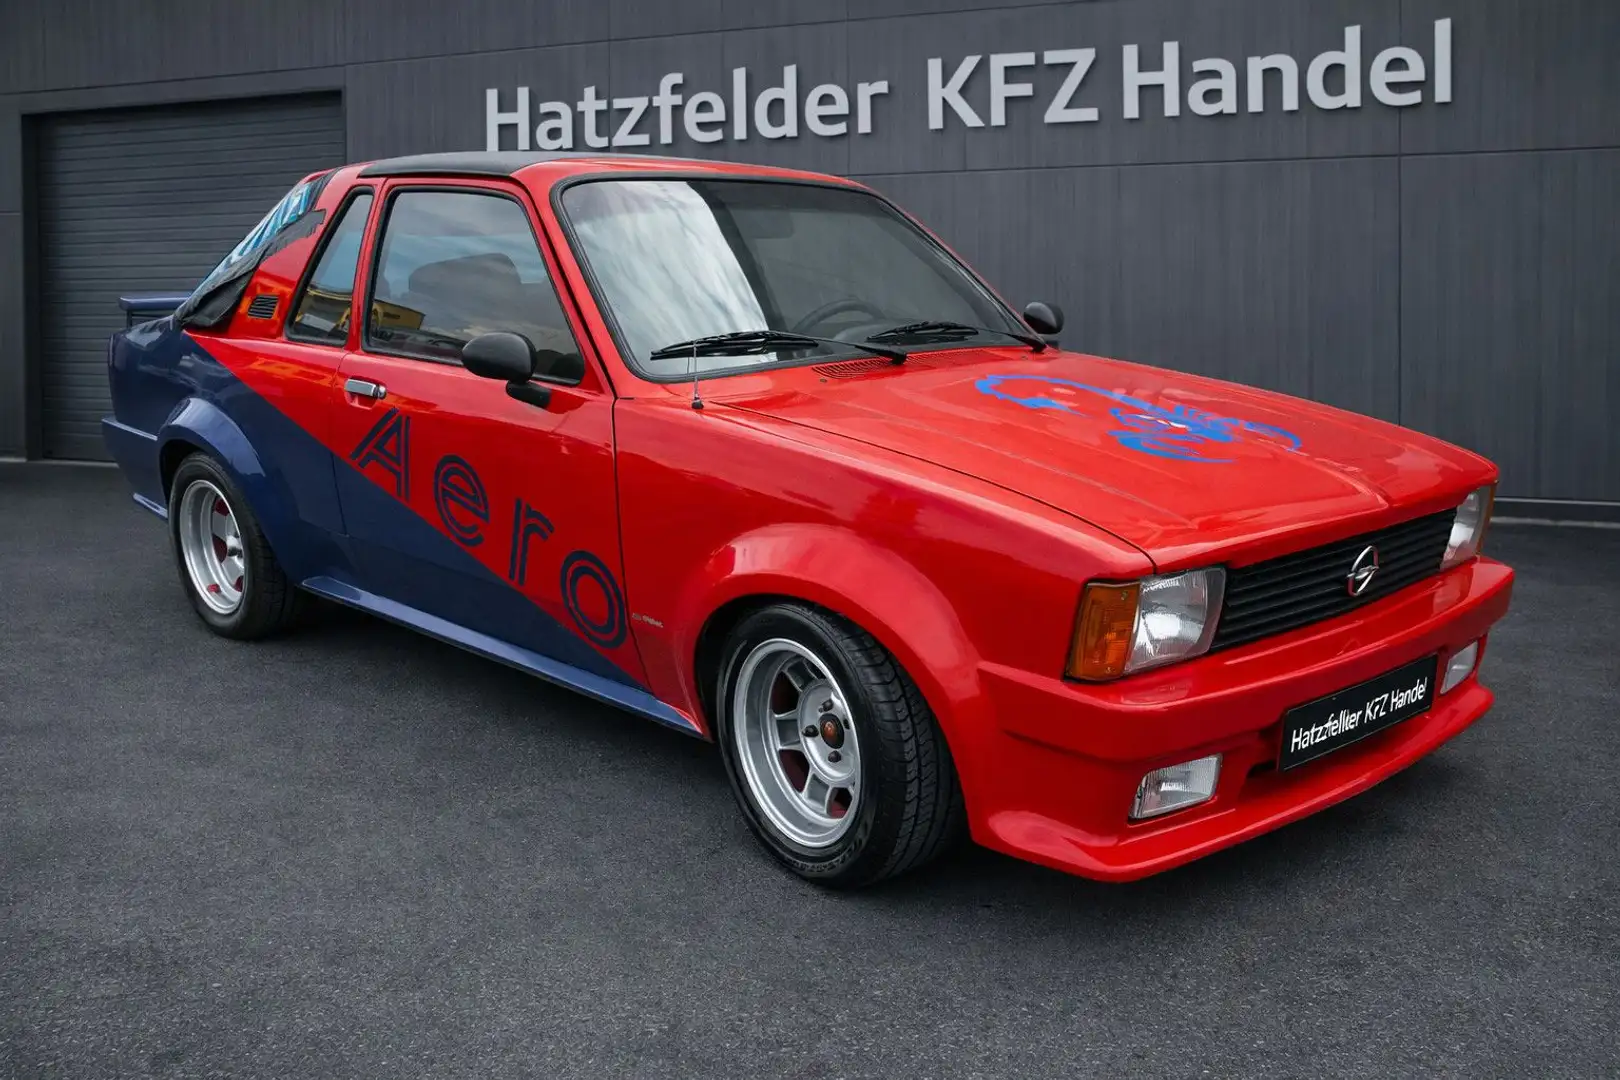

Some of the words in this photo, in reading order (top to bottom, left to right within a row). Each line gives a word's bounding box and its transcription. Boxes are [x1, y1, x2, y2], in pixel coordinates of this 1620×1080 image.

[486, 64, 889, 152] Hatzfelder
[928, 48, 1099, 129] KFZ
[1122, 18, 1452, 119] Handel
[350, 408, 627, 649] Aero
[1390, 677, 1428, 712] Handel
